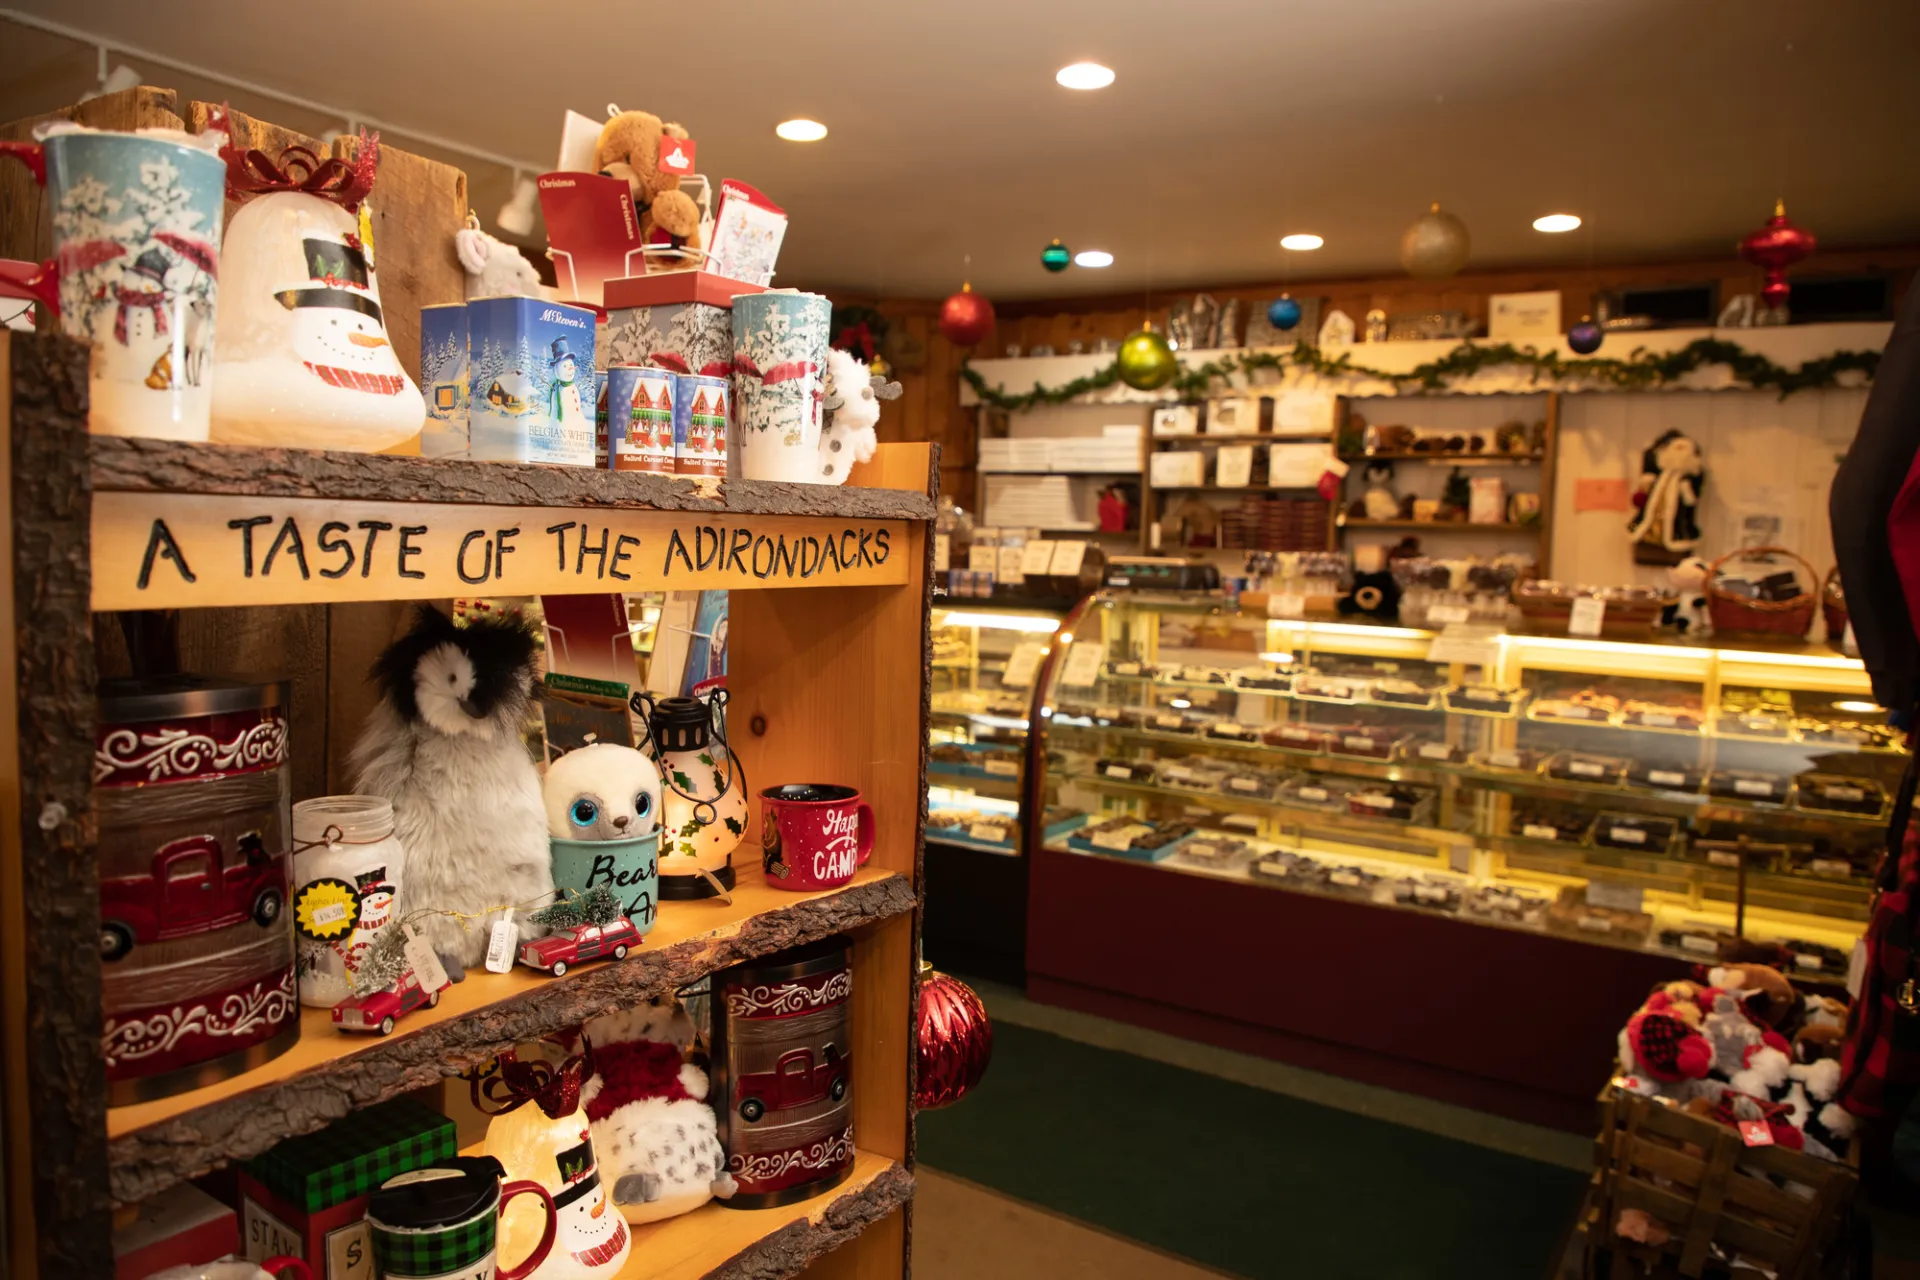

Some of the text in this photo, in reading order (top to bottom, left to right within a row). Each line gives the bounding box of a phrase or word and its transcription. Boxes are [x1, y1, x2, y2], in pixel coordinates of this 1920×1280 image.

[539, 178, 576, 189] Christmas
[722, 184, 749, 201] Christmas
[620, 193, 634, 240] Christmas
[528, 425, 595, 442] BELGIAN WHITE
[137, 515, 890, 590] A TASTE OF THE ADIRONDACKS
